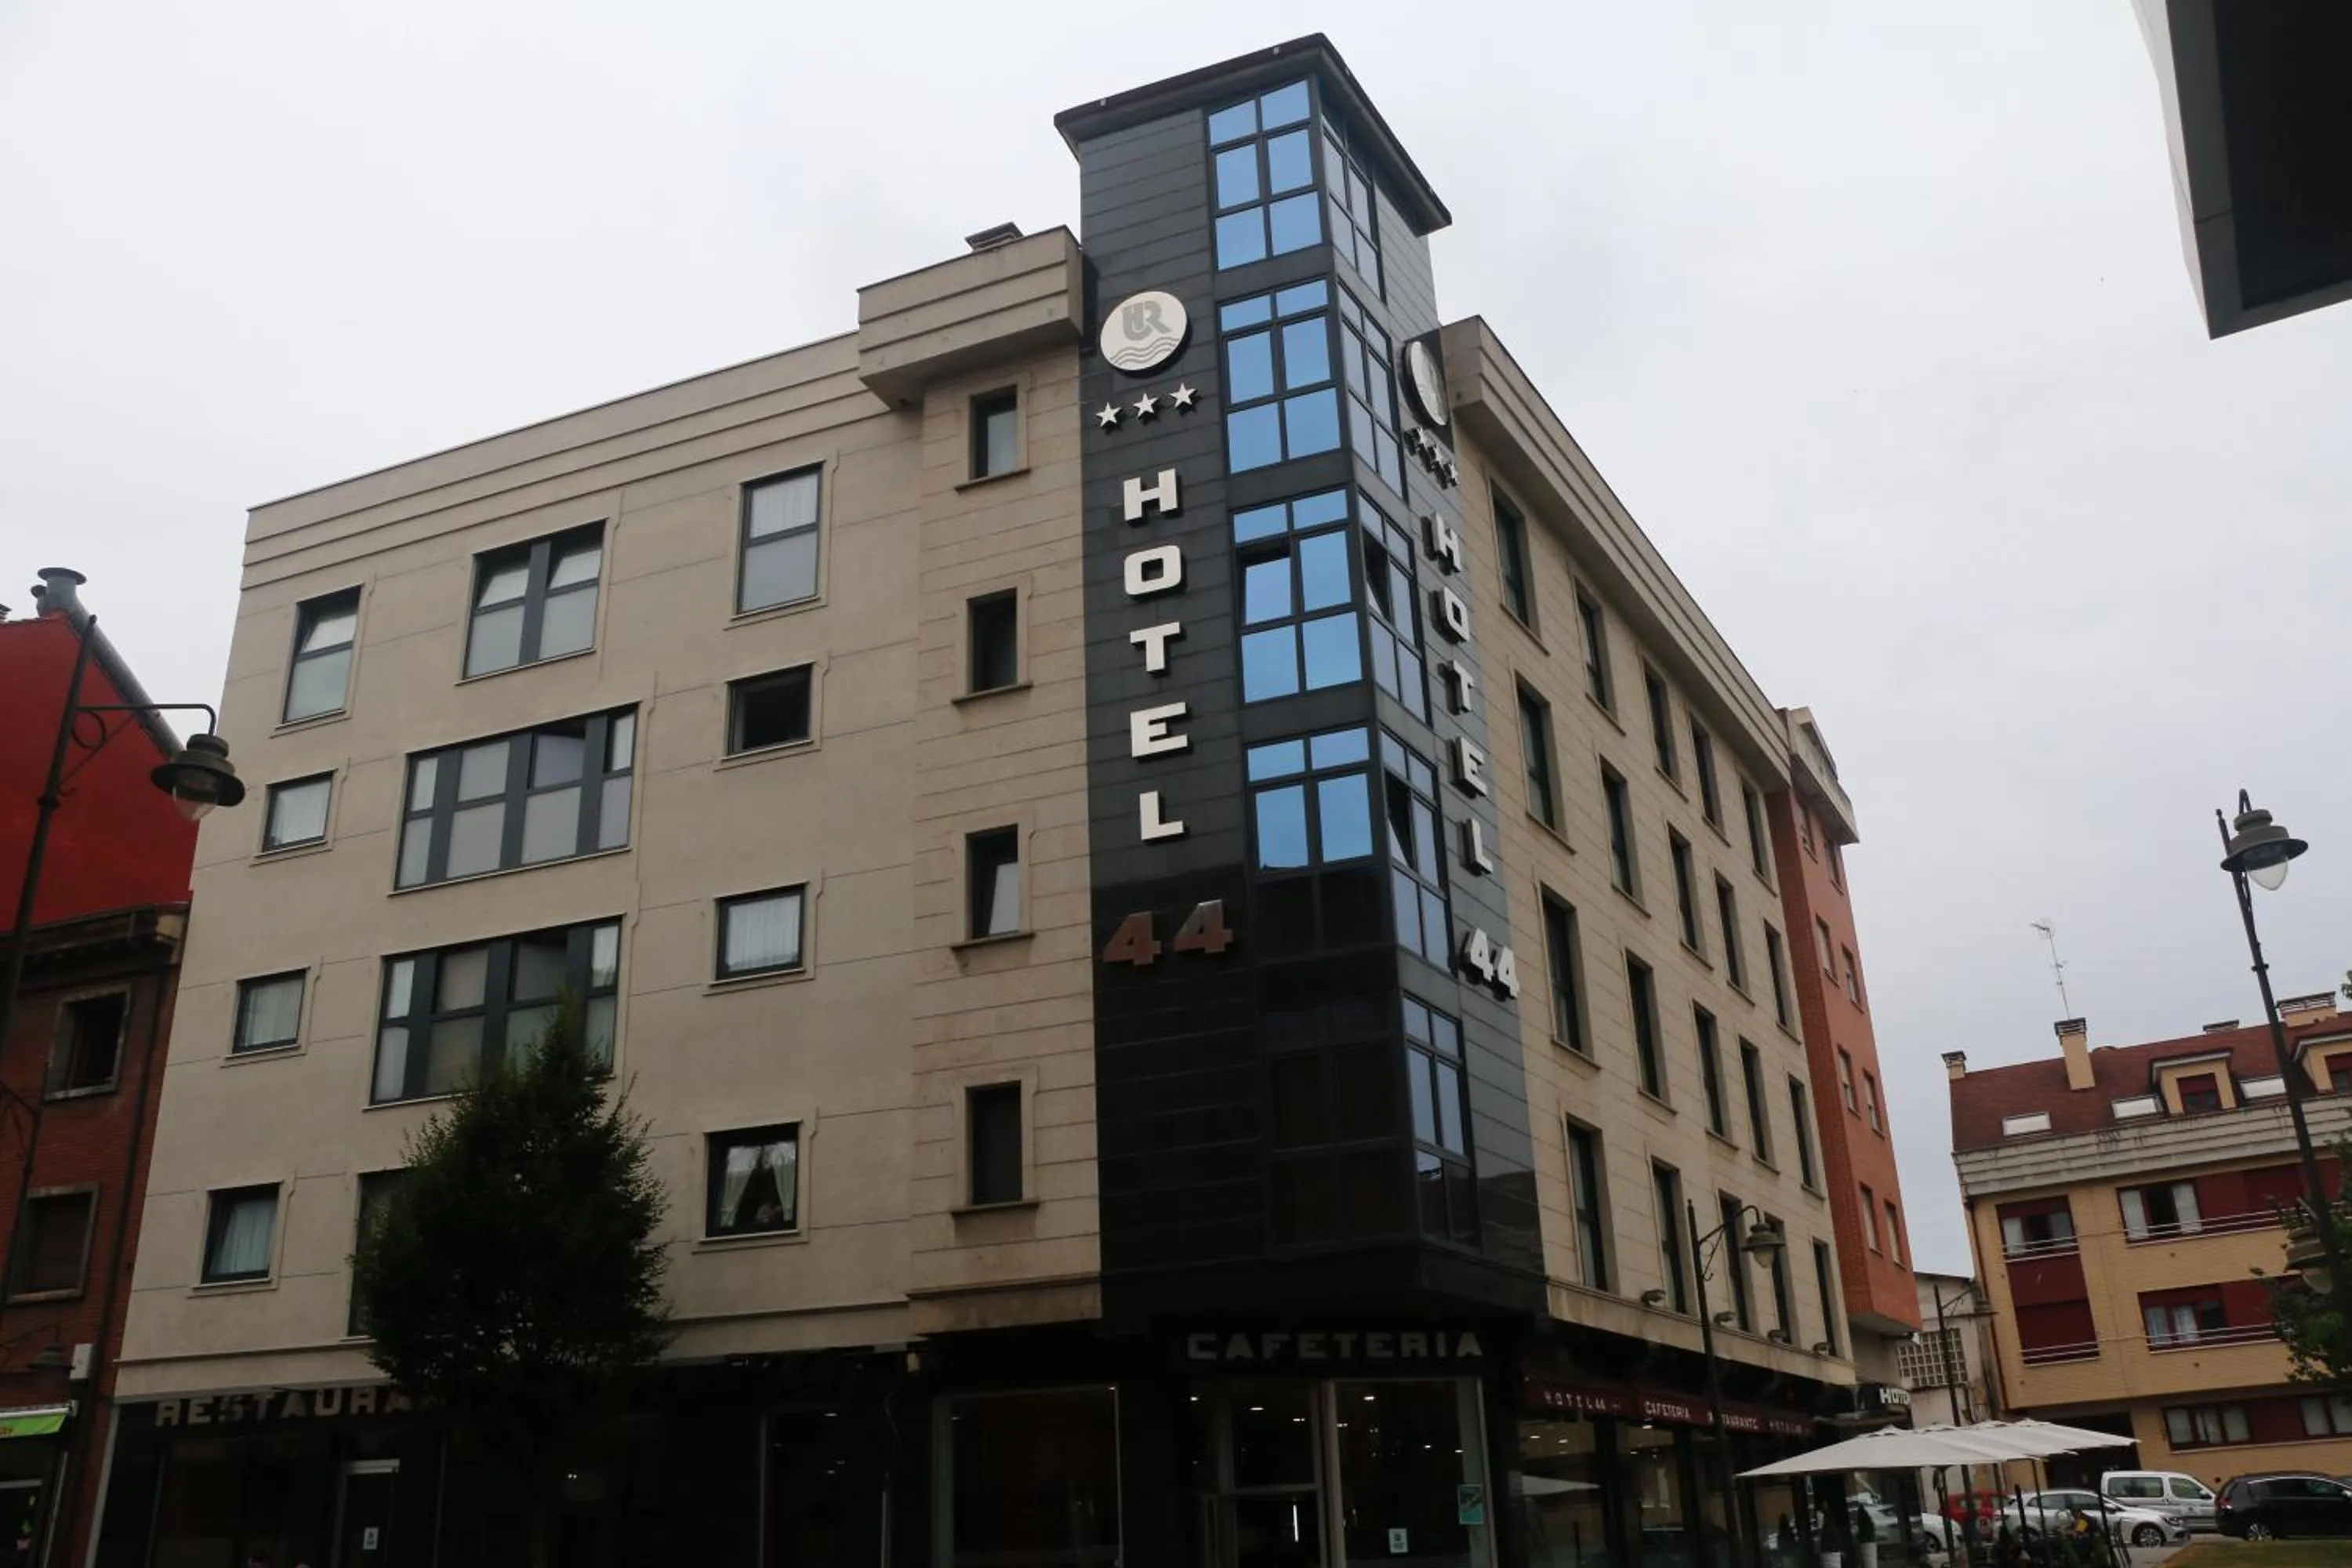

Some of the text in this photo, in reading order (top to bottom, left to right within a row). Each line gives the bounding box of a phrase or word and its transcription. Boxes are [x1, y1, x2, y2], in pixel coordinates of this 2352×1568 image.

[1102, 468, 1234, 967] HOTEL 44
[1430, 510, 1520, 1000] HOTEL 44
[154, 1386, 448, 1428] RESTAURA
[1186, 1330, 1483, 1360] CAFETERIA
